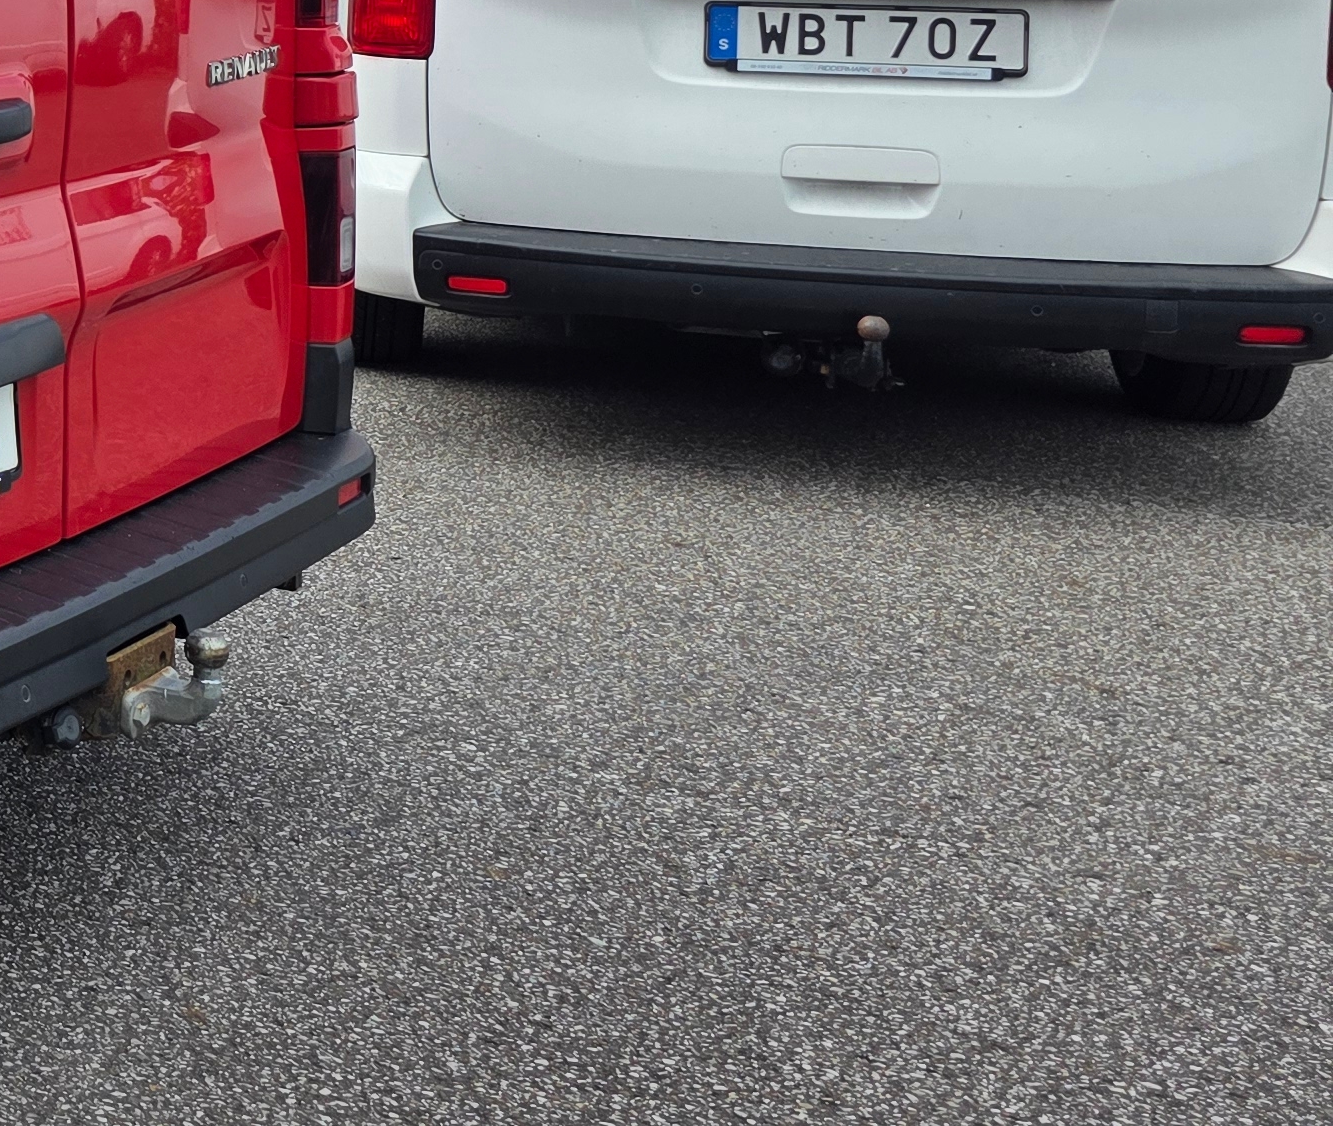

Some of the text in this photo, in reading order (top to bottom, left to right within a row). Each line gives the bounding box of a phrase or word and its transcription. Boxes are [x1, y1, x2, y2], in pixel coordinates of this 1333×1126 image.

[718, 38, 729, 50] S
[758, 12, 865, 57] WBT
[206, 44, 281, 88] RENAULT
